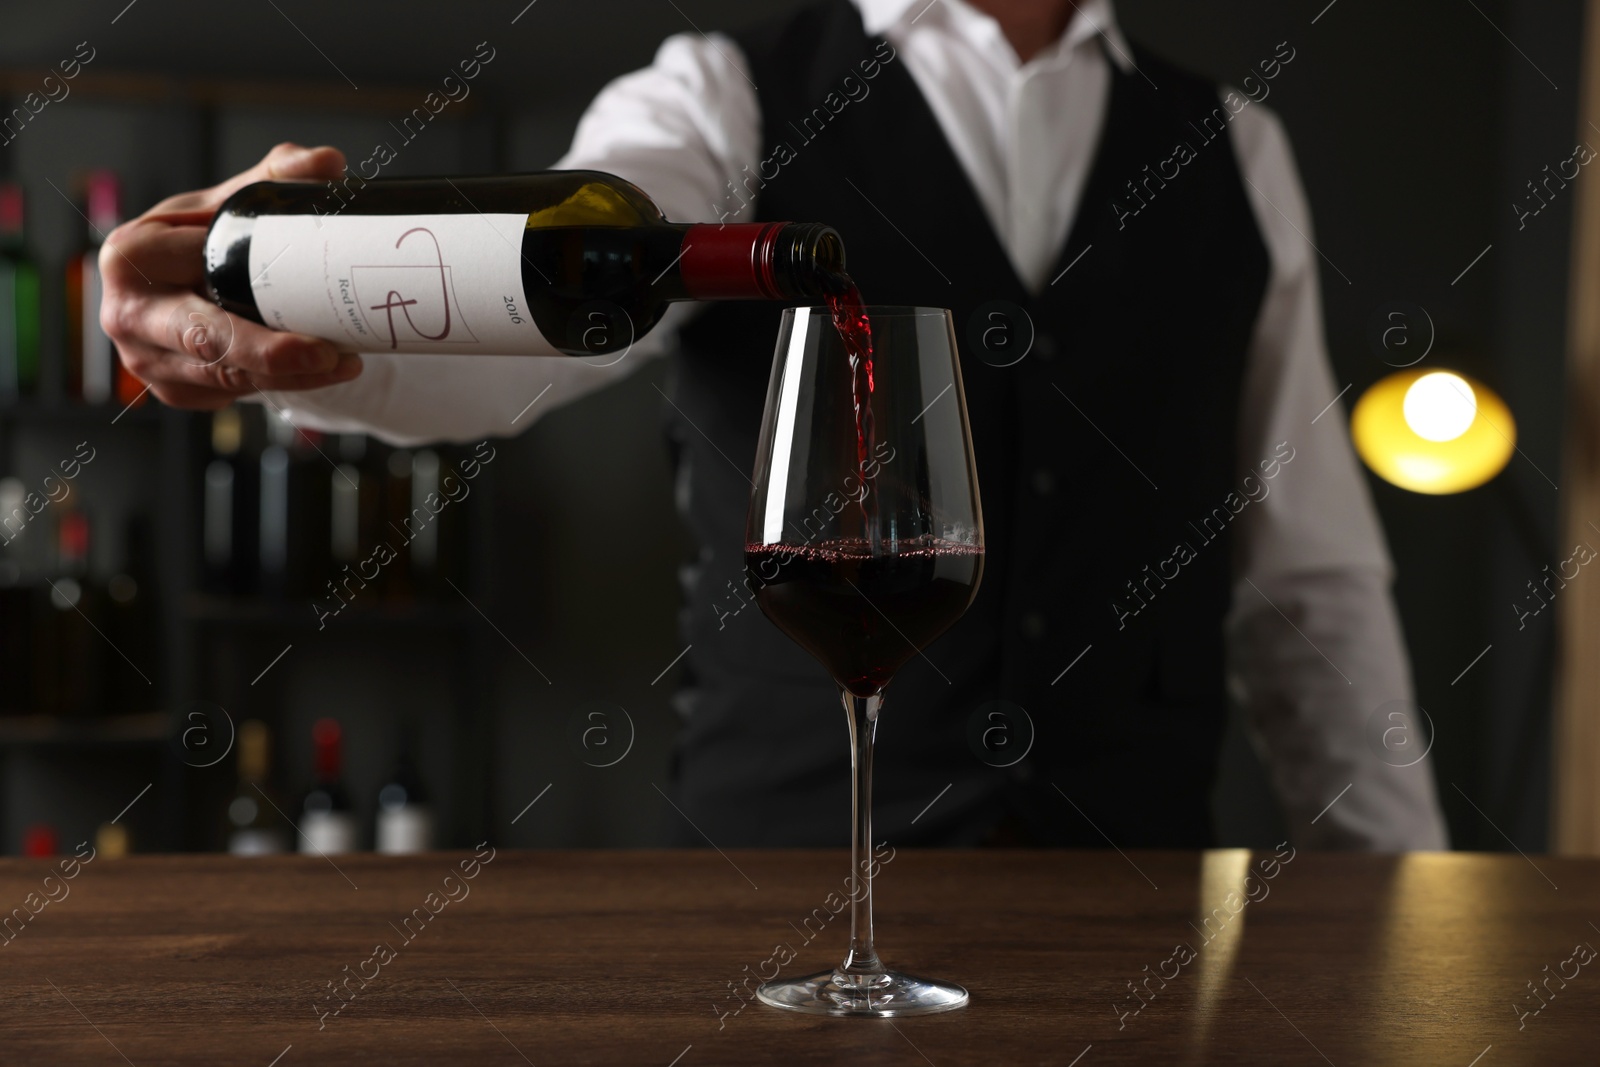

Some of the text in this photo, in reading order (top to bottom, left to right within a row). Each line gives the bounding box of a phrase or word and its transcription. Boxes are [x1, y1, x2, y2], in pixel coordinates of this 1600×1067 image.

[338, 278, 367, 335] Red wine
[503, 295, 527, 325] 2016
